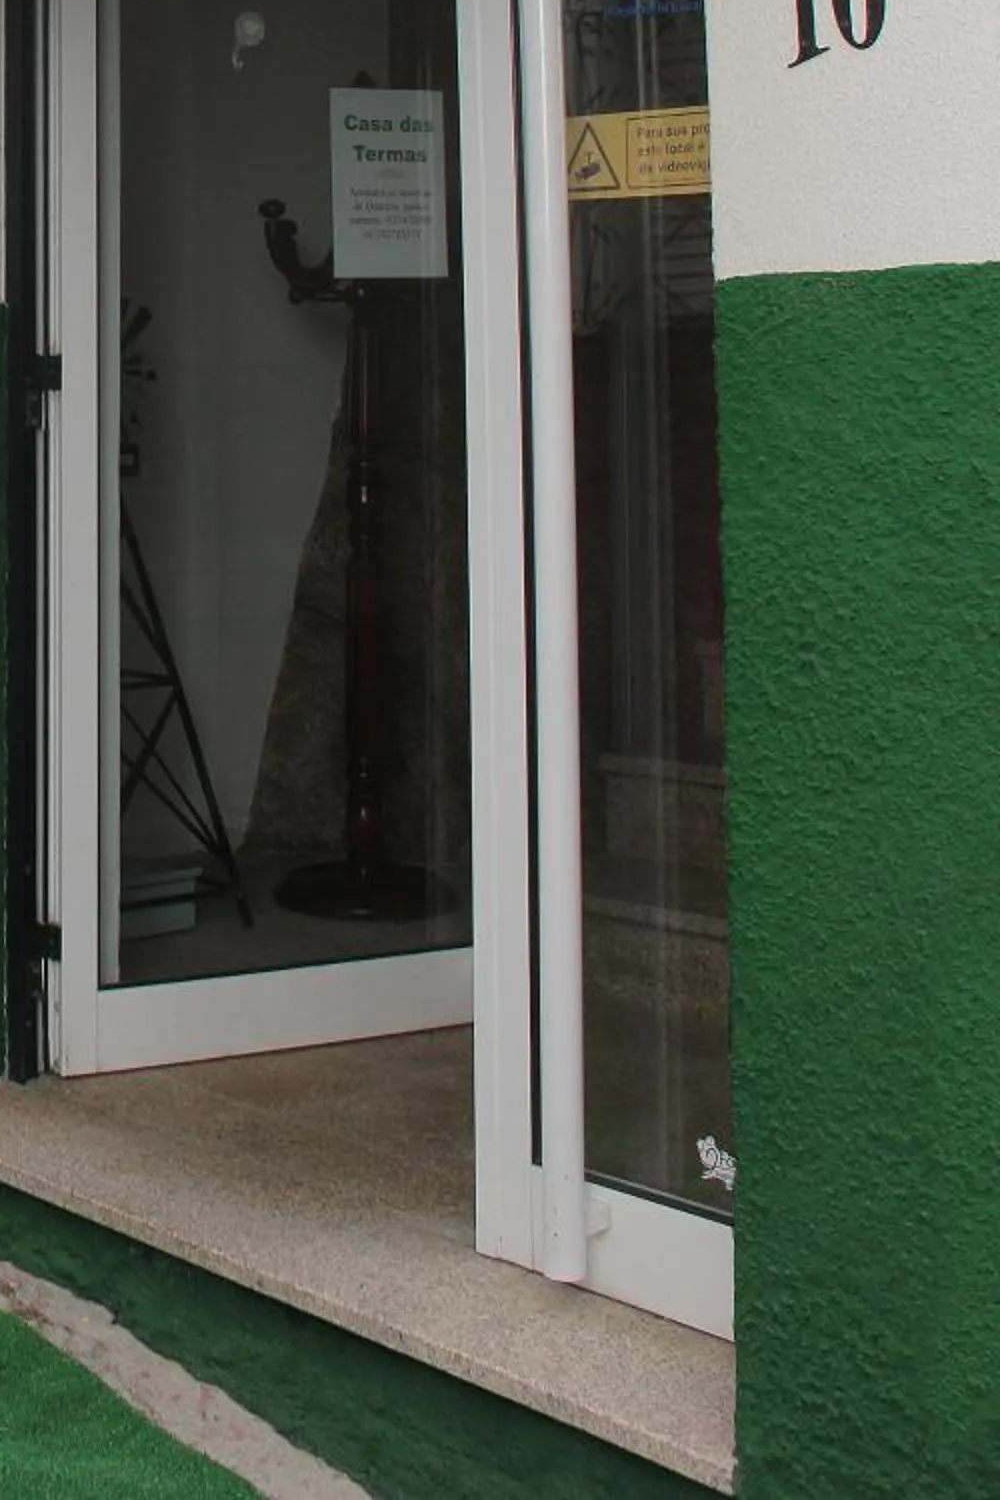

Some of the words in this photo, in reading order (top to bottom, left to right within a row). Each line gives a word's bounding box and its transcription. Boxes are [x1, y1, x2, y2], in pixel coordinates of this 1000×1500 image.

[344, 114, 393, 132] Casa
[400, 116, 435, 132] das
[353, 144, 428, 163] Termas
